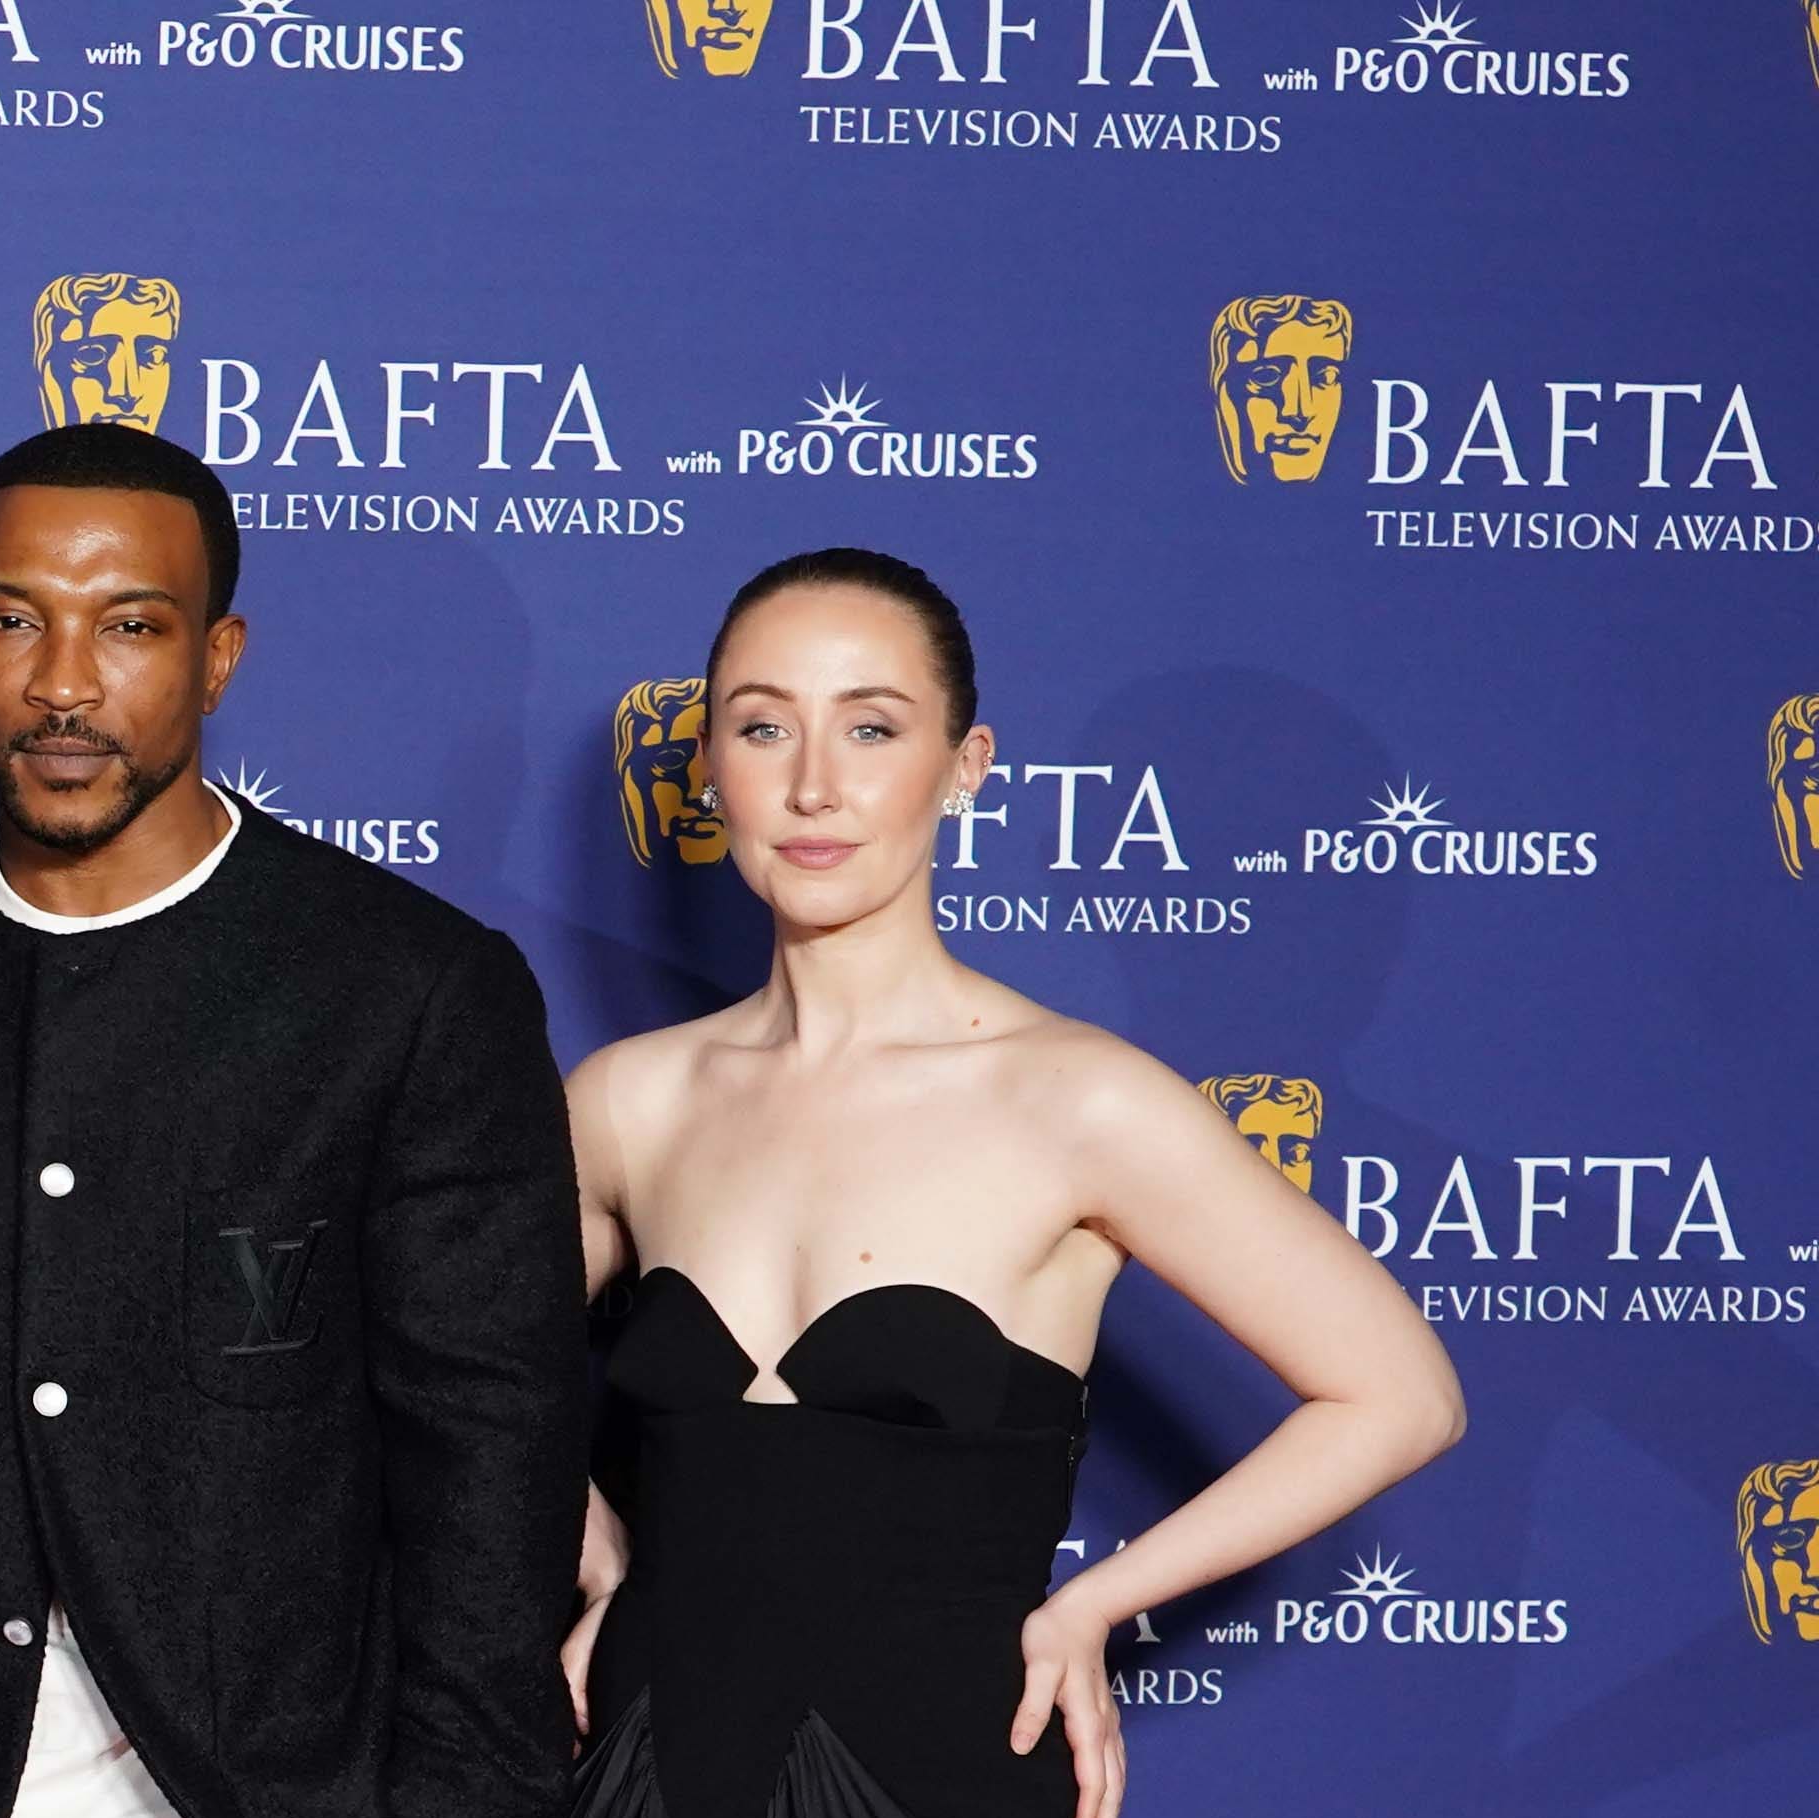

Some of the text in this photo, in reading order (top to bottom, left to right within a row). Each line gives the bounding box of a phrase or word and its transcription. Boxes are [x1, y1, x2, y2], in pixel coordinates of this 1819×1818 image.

[85, 21, 464, 72] with P&O CRUISES
[1263, 47, 1629, 96] with P&O CRUISES
[799, 106, 1281, 153] TELEVISION AWARDS
[201, 358, 622, 472] BAFTA
[1367, 379, 1778, 490] BAFTA
[666, 429, 1036, 478] with P&O CRUISES
[234, 493, 684, 536] ELEVISION AWARDS
[1366, 510, 1819, 552] TELEVISION AWARD
[282, 818, 439, 865] ISES
[931, 765, 1189, 871] FTA
[1233, 829, 1597, 876] with P&O CRUISES
[1064, 897, 1251, 934] AWARDS
[1342, 1156, 1745, 1260] BAFTA
[1789, 1240, 1819, 1262] wi
[1403, 1286, 1806, 1322] EVISION AWARDS
[1205, 1599, 1567, 1644] with P&O CRUISES
[1109, 1670, 1222, 1705] ARDS
